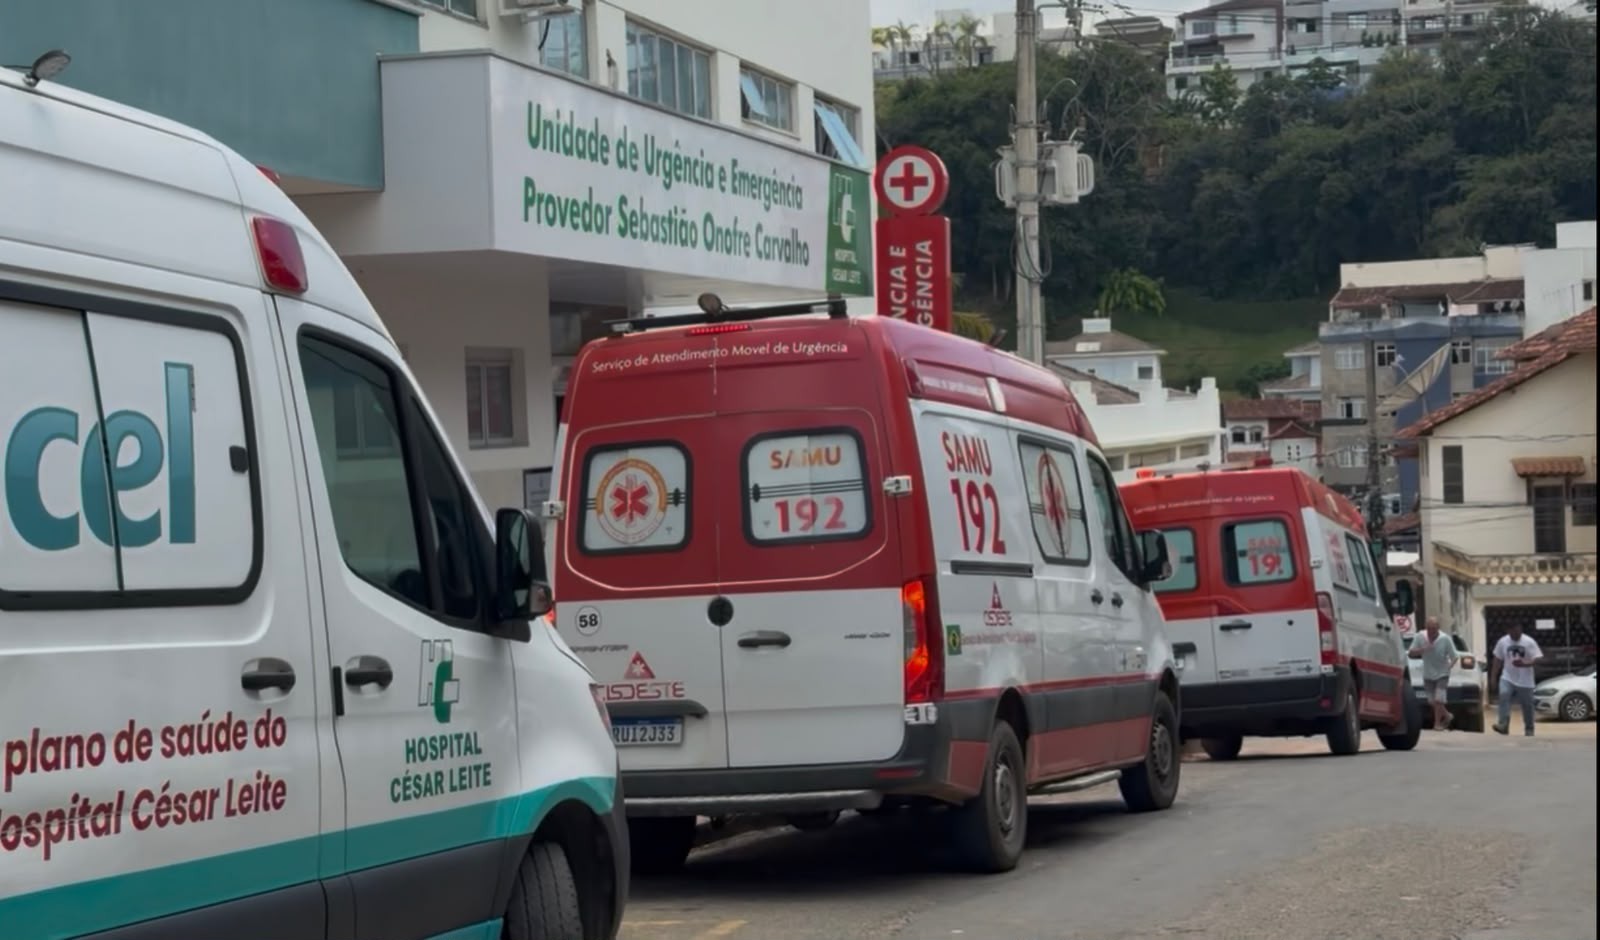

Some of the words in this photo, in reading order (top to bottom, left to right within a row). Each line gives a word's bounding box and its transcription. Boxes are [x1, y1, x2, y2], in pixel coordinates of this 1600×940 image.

[527, 101, 610, 166] Unidade
[616, 125, 639, 172] de
[644, 133, 715, 191] Urgência
[718, 165, 727, 193] e
[731, 158, 803, 213] Emergência
[524, 176, 612, 235] Provedor
[617, 194, 698, 249] Sebastião
[703, 212, 751, 258] Onofre
[755, 222, 809, 266] Carvalho
[889, 245, 906, 257] E
[912, 240, 934, 328] GÊNCIA
[591, 356, 632, 373] Serviço
[634, 355, 649, 367] de
[651, 347, 728, 364] Atendimento
[731, 343, 770, 356] Movel
[773, 342, 788, 354] de
[792, 341, 848, 355] Urgência
[5, 361, 196, 551] cel
[941, 431, 992, 477] SAMU
[774, 497, 848, 533] 192
[949, 478, 1006, 554] 192
[578, 613, 599, 628] 58
[5, 728, 106, 792] plano
[113, 719, 153, 763] de
[160, 709, 248, 759] saúde
[254, 708, 287, 748] do
[405, 731, 482, 764] HOSPITAL
[390, 769, 445, 803] CÉSAR
[449, 762, 492, 793] LEITE
[0, 790, 125, 860] ospital
[131, 780, 220, 831] César
[225, 769, 287, 818] Leite
